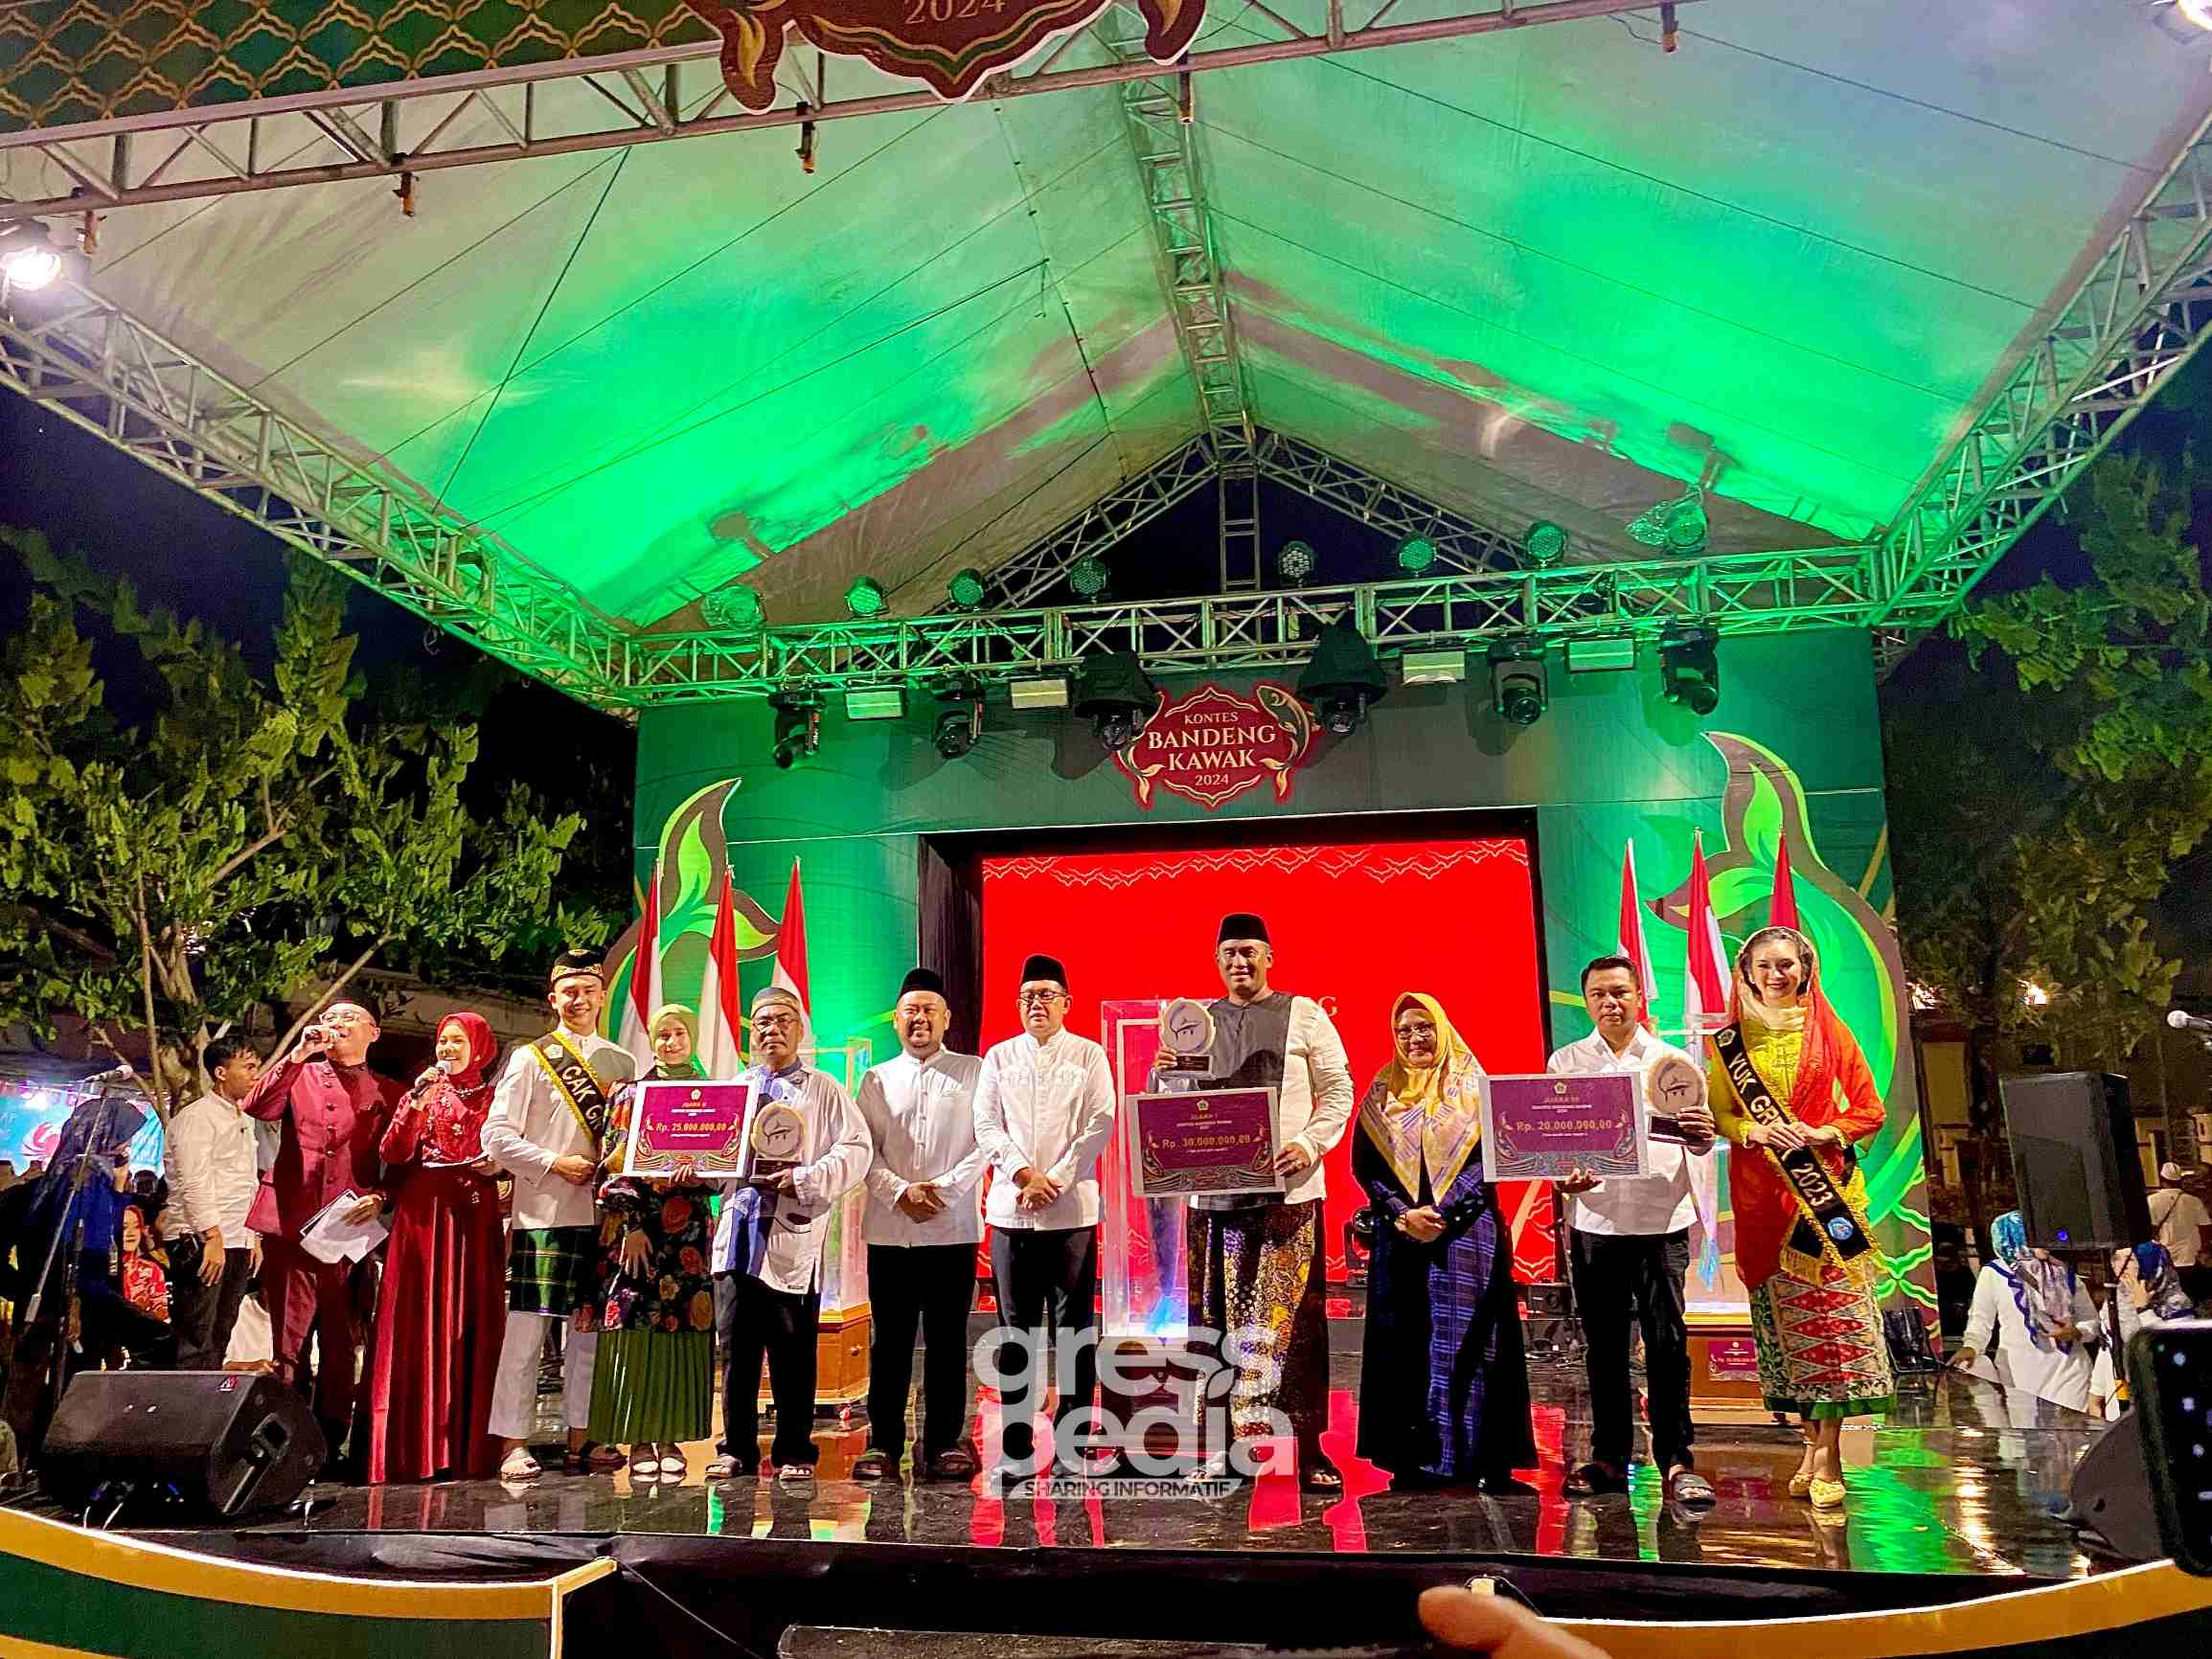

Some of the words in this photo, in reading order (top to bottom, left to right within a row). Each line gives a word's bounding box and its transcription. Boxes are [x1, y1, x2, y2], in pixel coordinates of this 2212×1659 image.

[1184, 712, 1238, 724] KONTES
[1148, 725, 1276, 749] BANDENG
[1168, 749, 1256, 771] KAWAK
[1194, 773, 1229, 786] 2024
[561, 1065, 597, 1103] CAK
[1727, 1052, 1757, 1095] YUK
[1790, 1162, 1834, 1208] 2023
